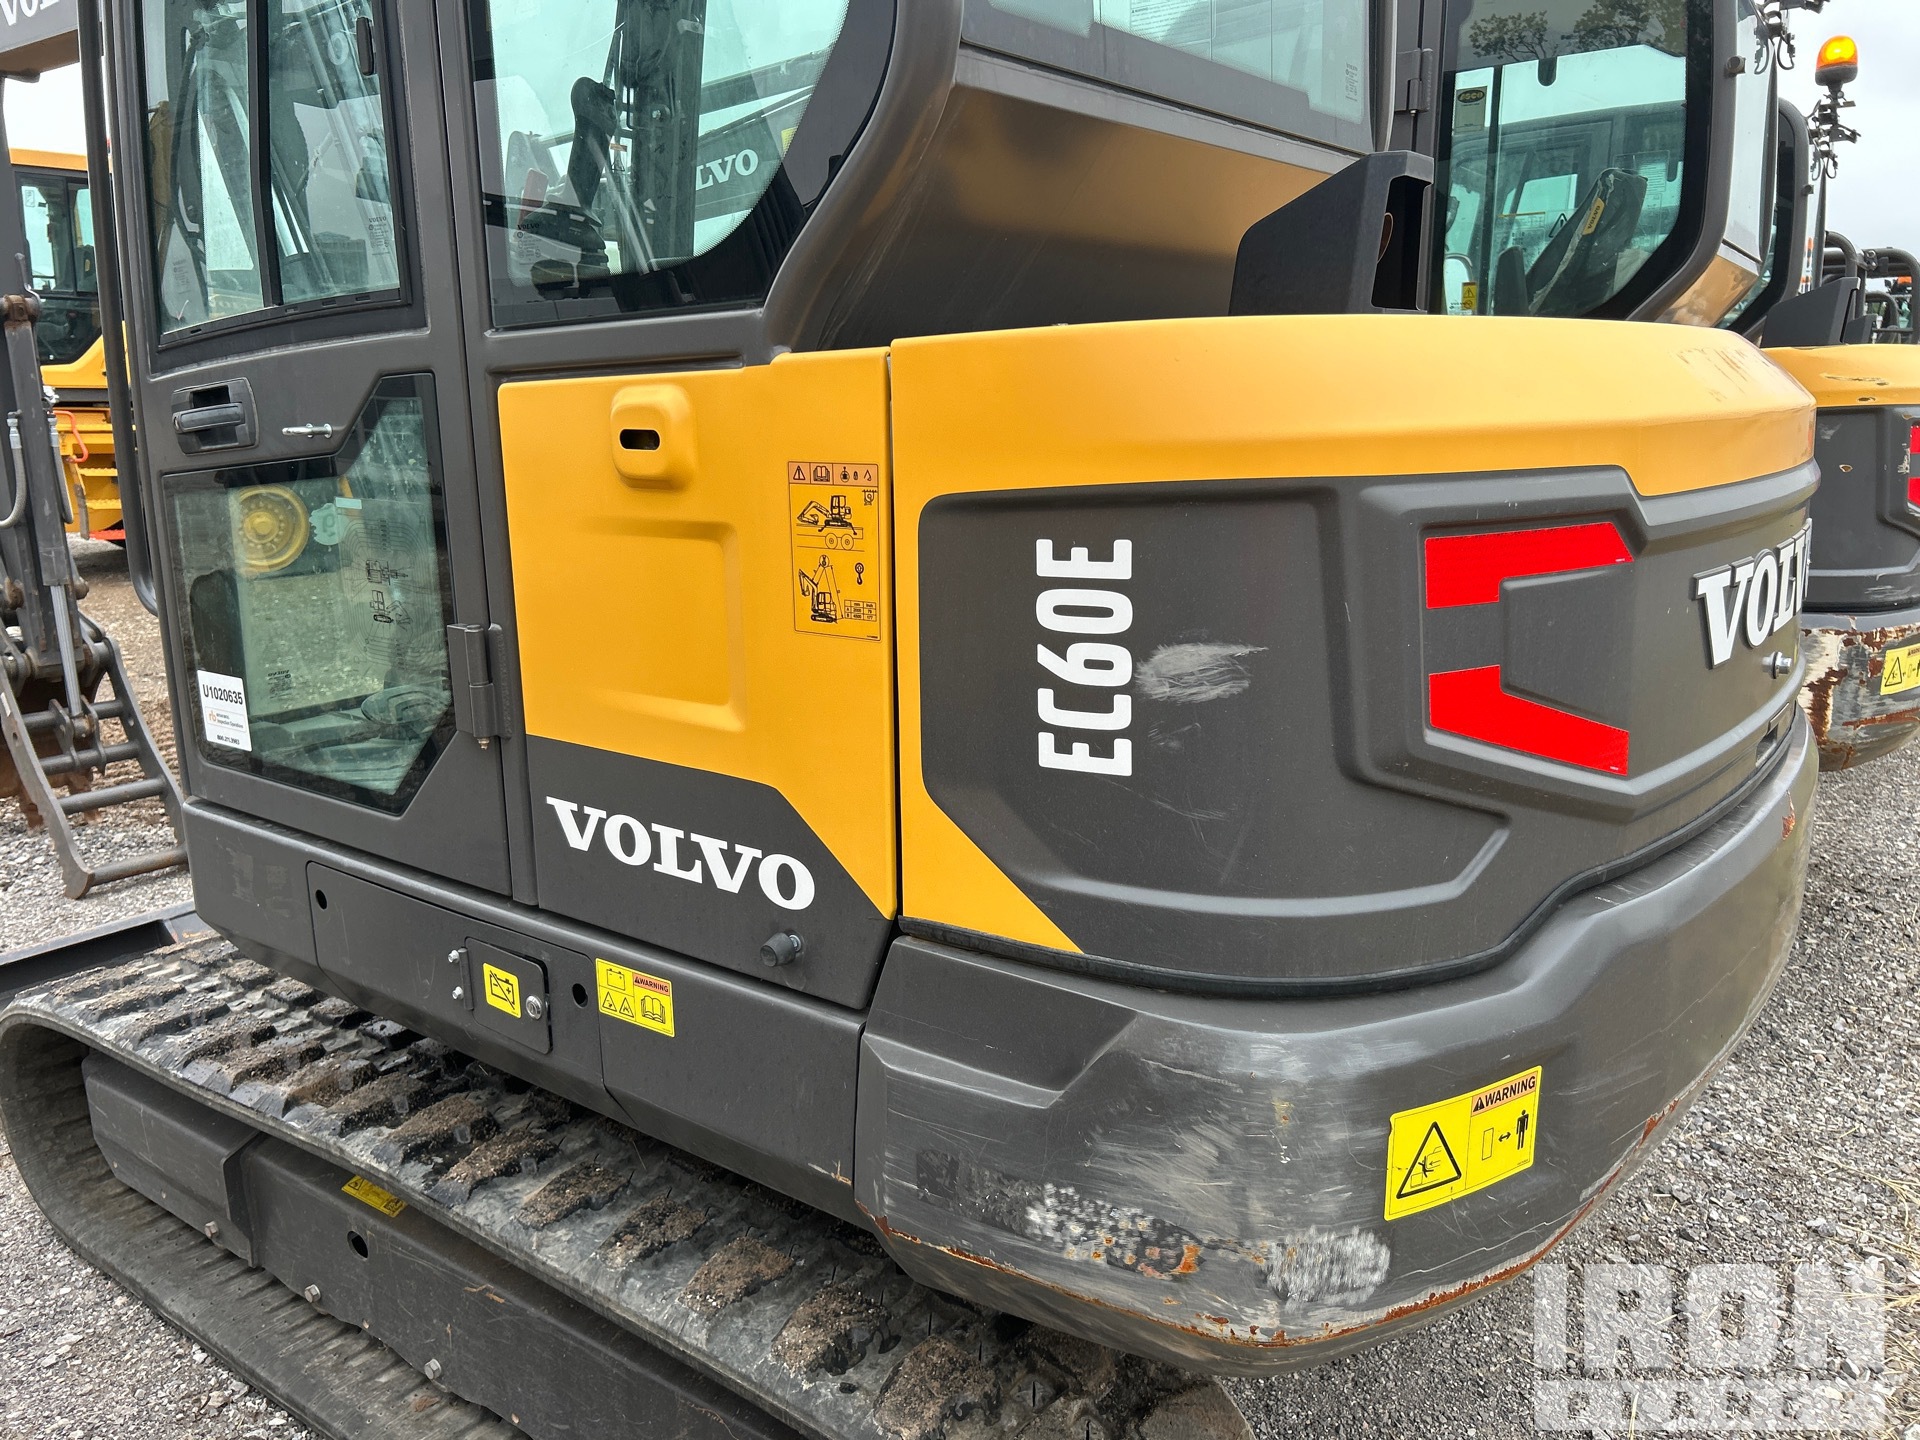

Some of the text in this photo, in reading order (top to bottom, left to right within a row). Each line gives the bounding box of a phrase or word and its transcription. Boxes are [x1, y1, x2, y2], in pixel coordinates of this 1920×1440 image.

[1036, 539, 1133, 777] EC60E
[203, 684, 243, 705] U1020635
[546, 796, 815, 911] VOLVO
[638, 977, 669, 993] WARNING
[1484, 1075, 1536, 1107] WARNING
